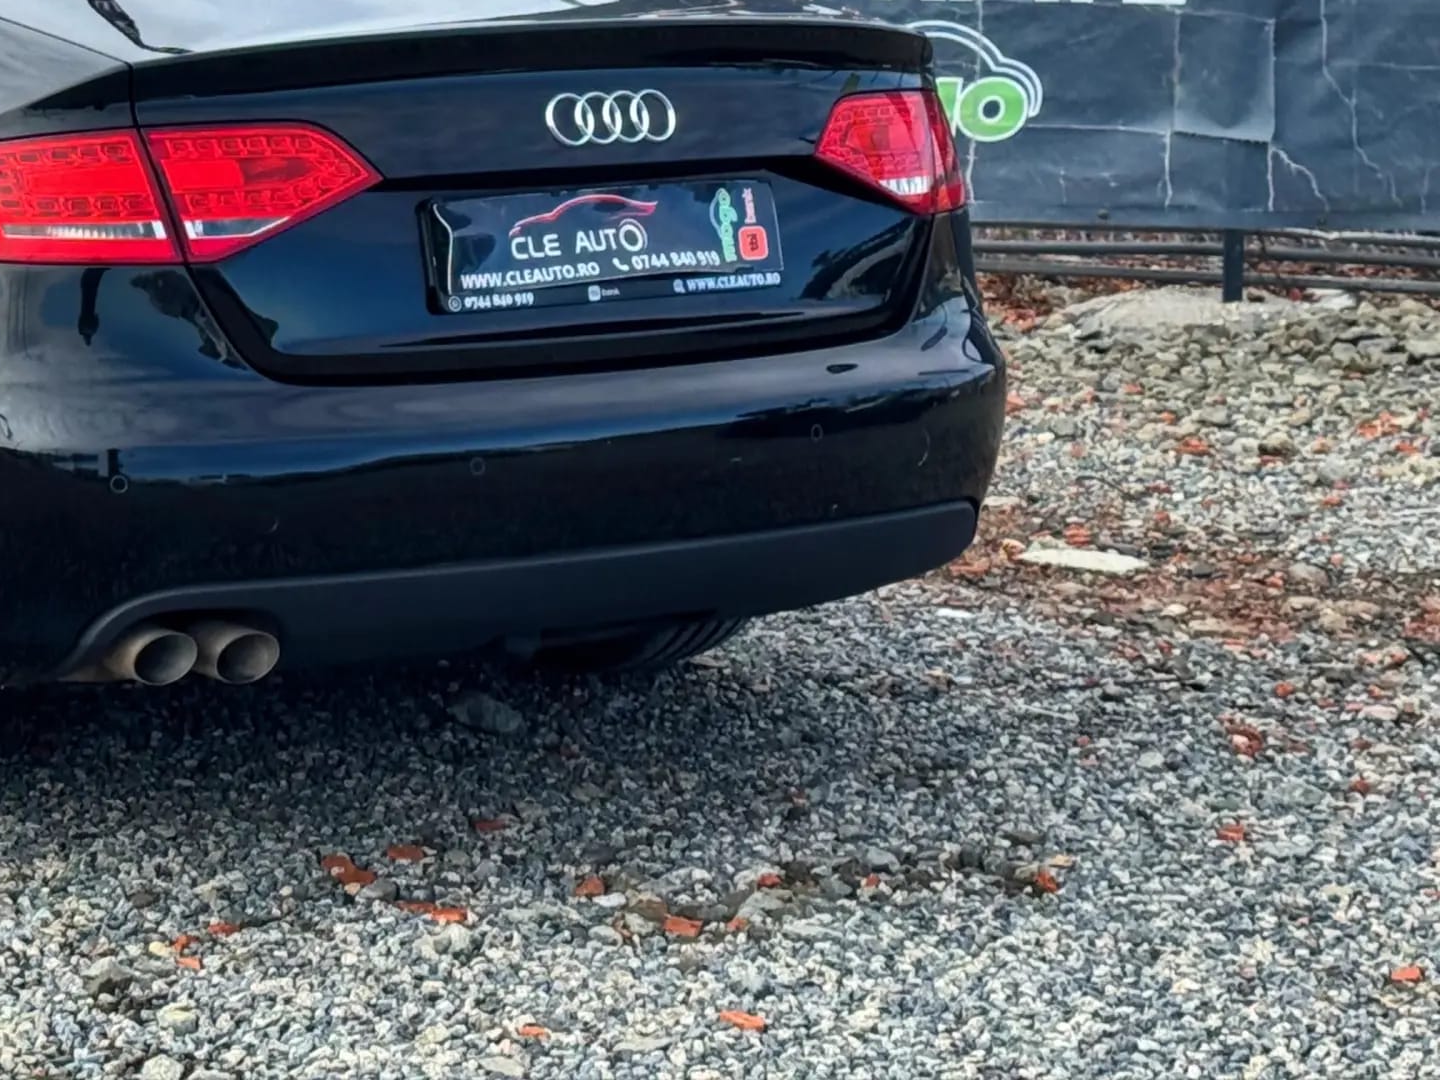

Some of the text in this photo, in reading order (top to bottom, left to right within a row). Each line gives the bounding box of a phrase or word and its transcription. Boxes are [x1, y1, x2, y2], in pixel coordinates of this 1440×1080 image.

[511, 218, 645, 261] CLE AUTO
[632, 250, 720, 271] 0744 840 919
[461, 261, 600, 289] WWW.CLEAUTO.RO
[686, 272, 781, 292] WWW.CLEAUTO.RO
